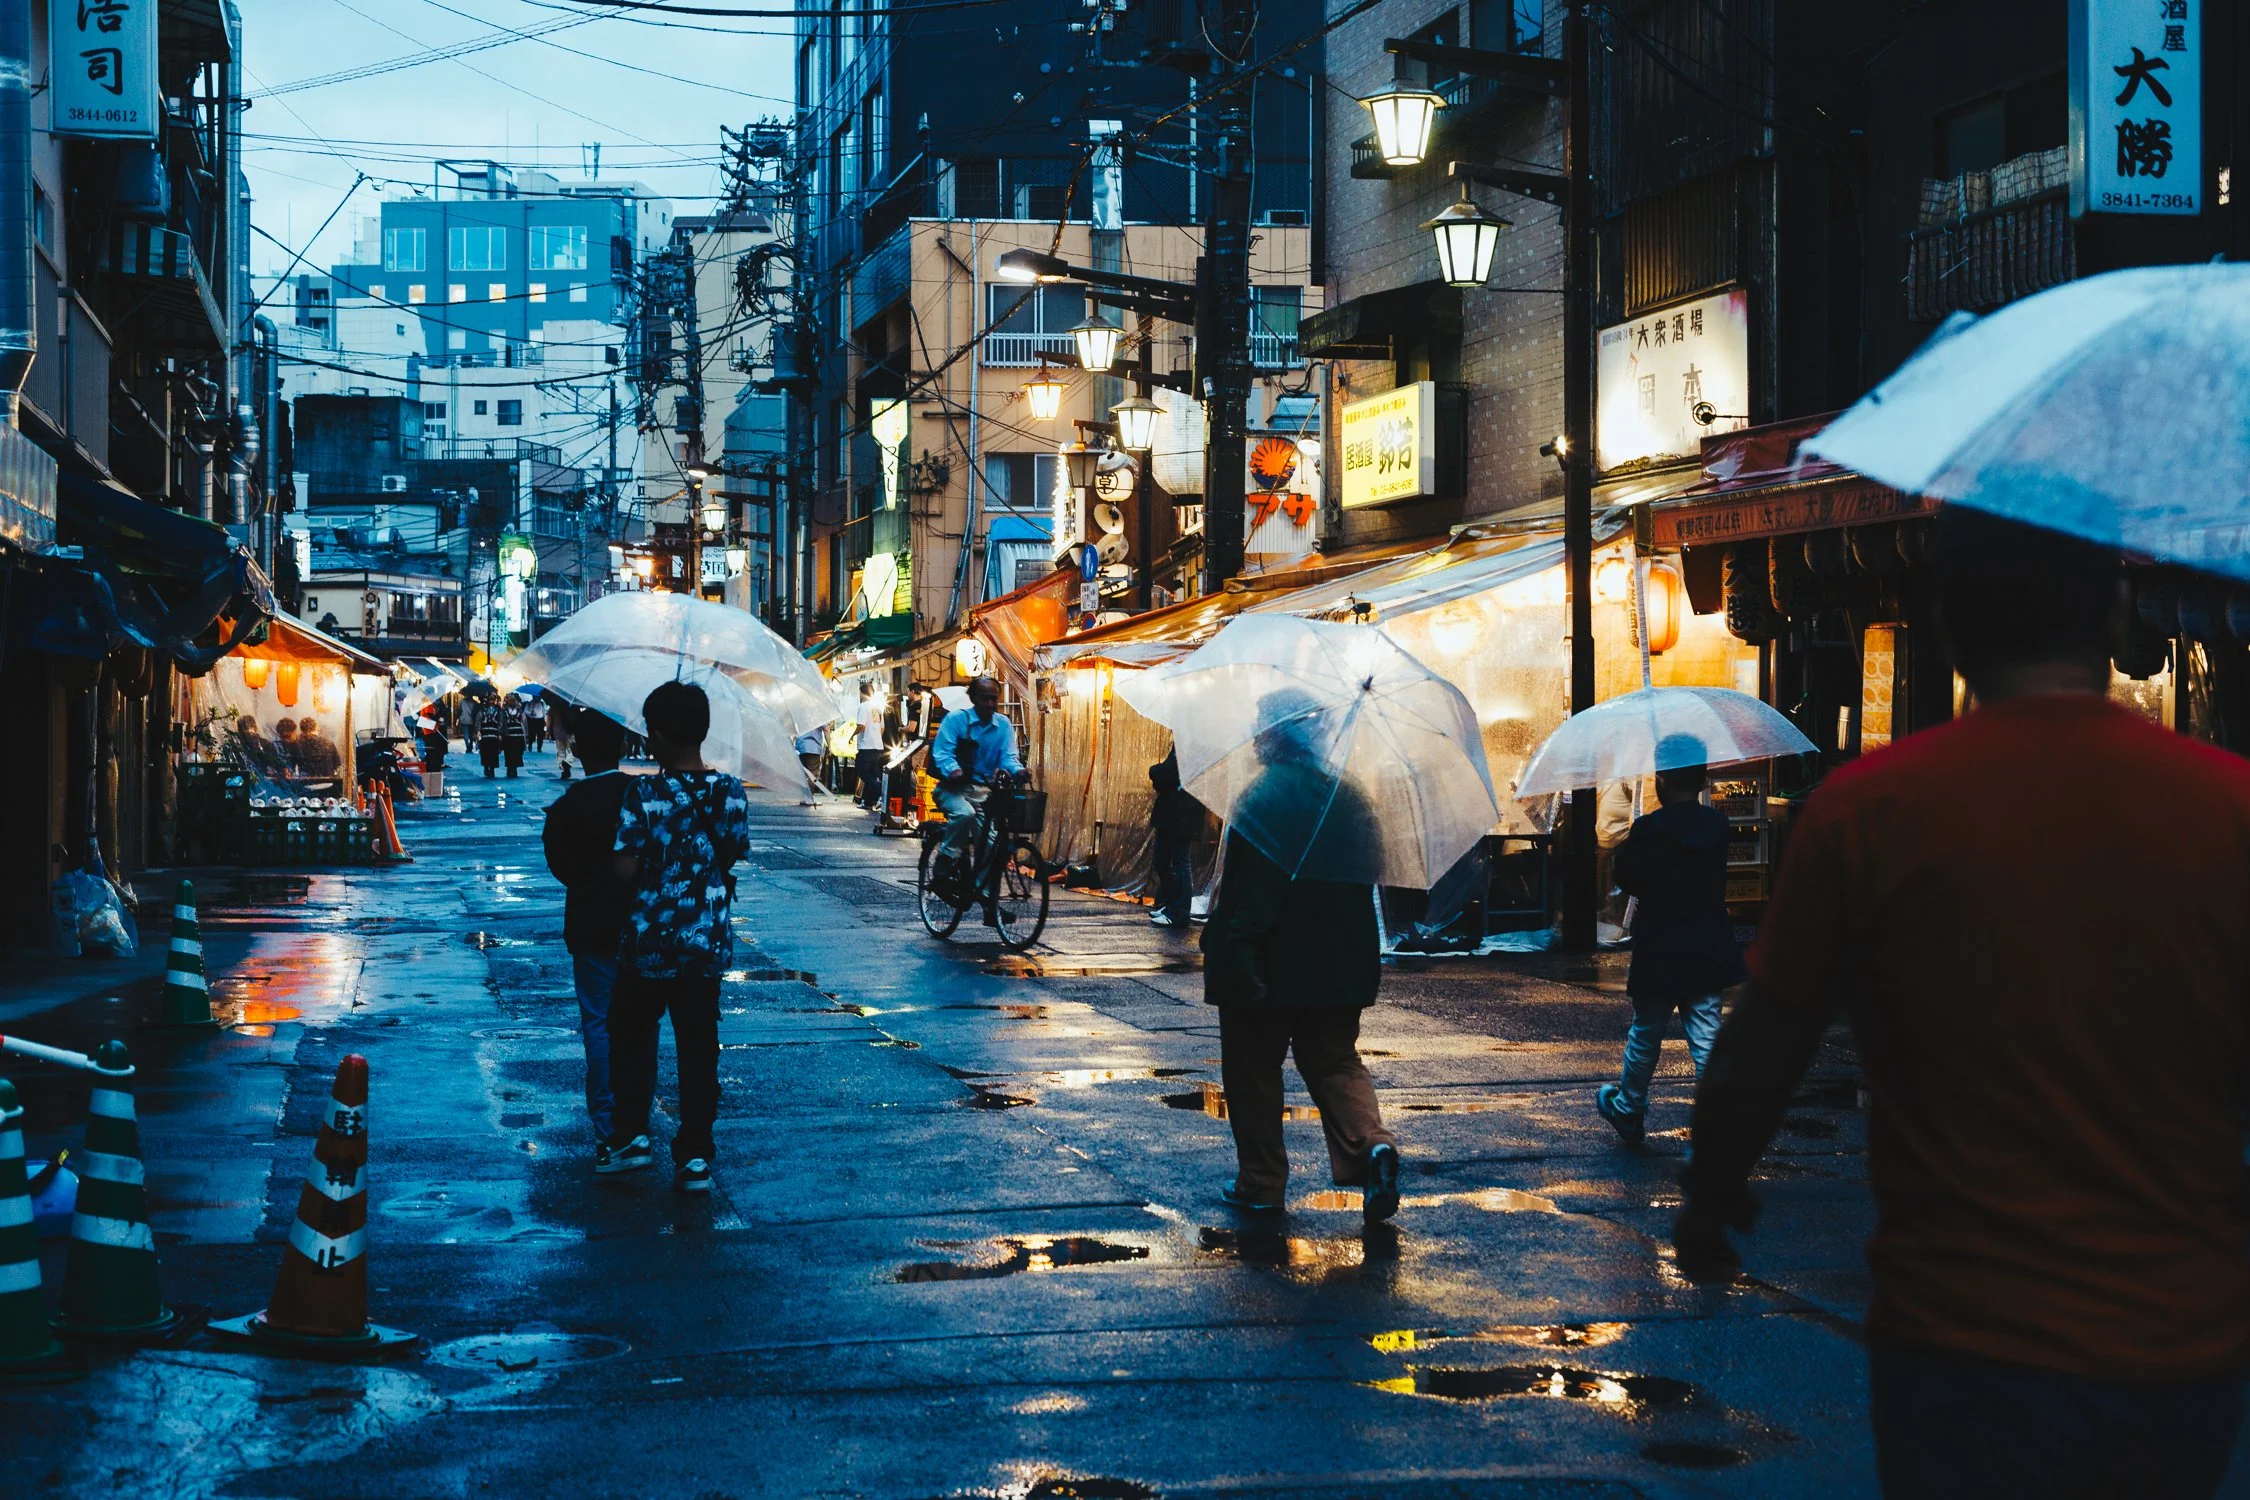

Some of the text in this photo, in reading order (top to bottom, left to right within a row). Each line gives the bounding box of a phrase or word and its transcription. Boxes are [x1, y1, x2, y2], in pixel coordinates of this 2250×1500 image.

[68, 107, 138, 122] 3844-0612
[2113, 46, 2173, 179] 大勝
[2101, 191, 2194, 209] 3841-7364
[1636, 308, 1703, 351] 大衆酒場
[882, 446, 898, 493] つくし
[1345, 438, 1373, 472] 居酒屋
